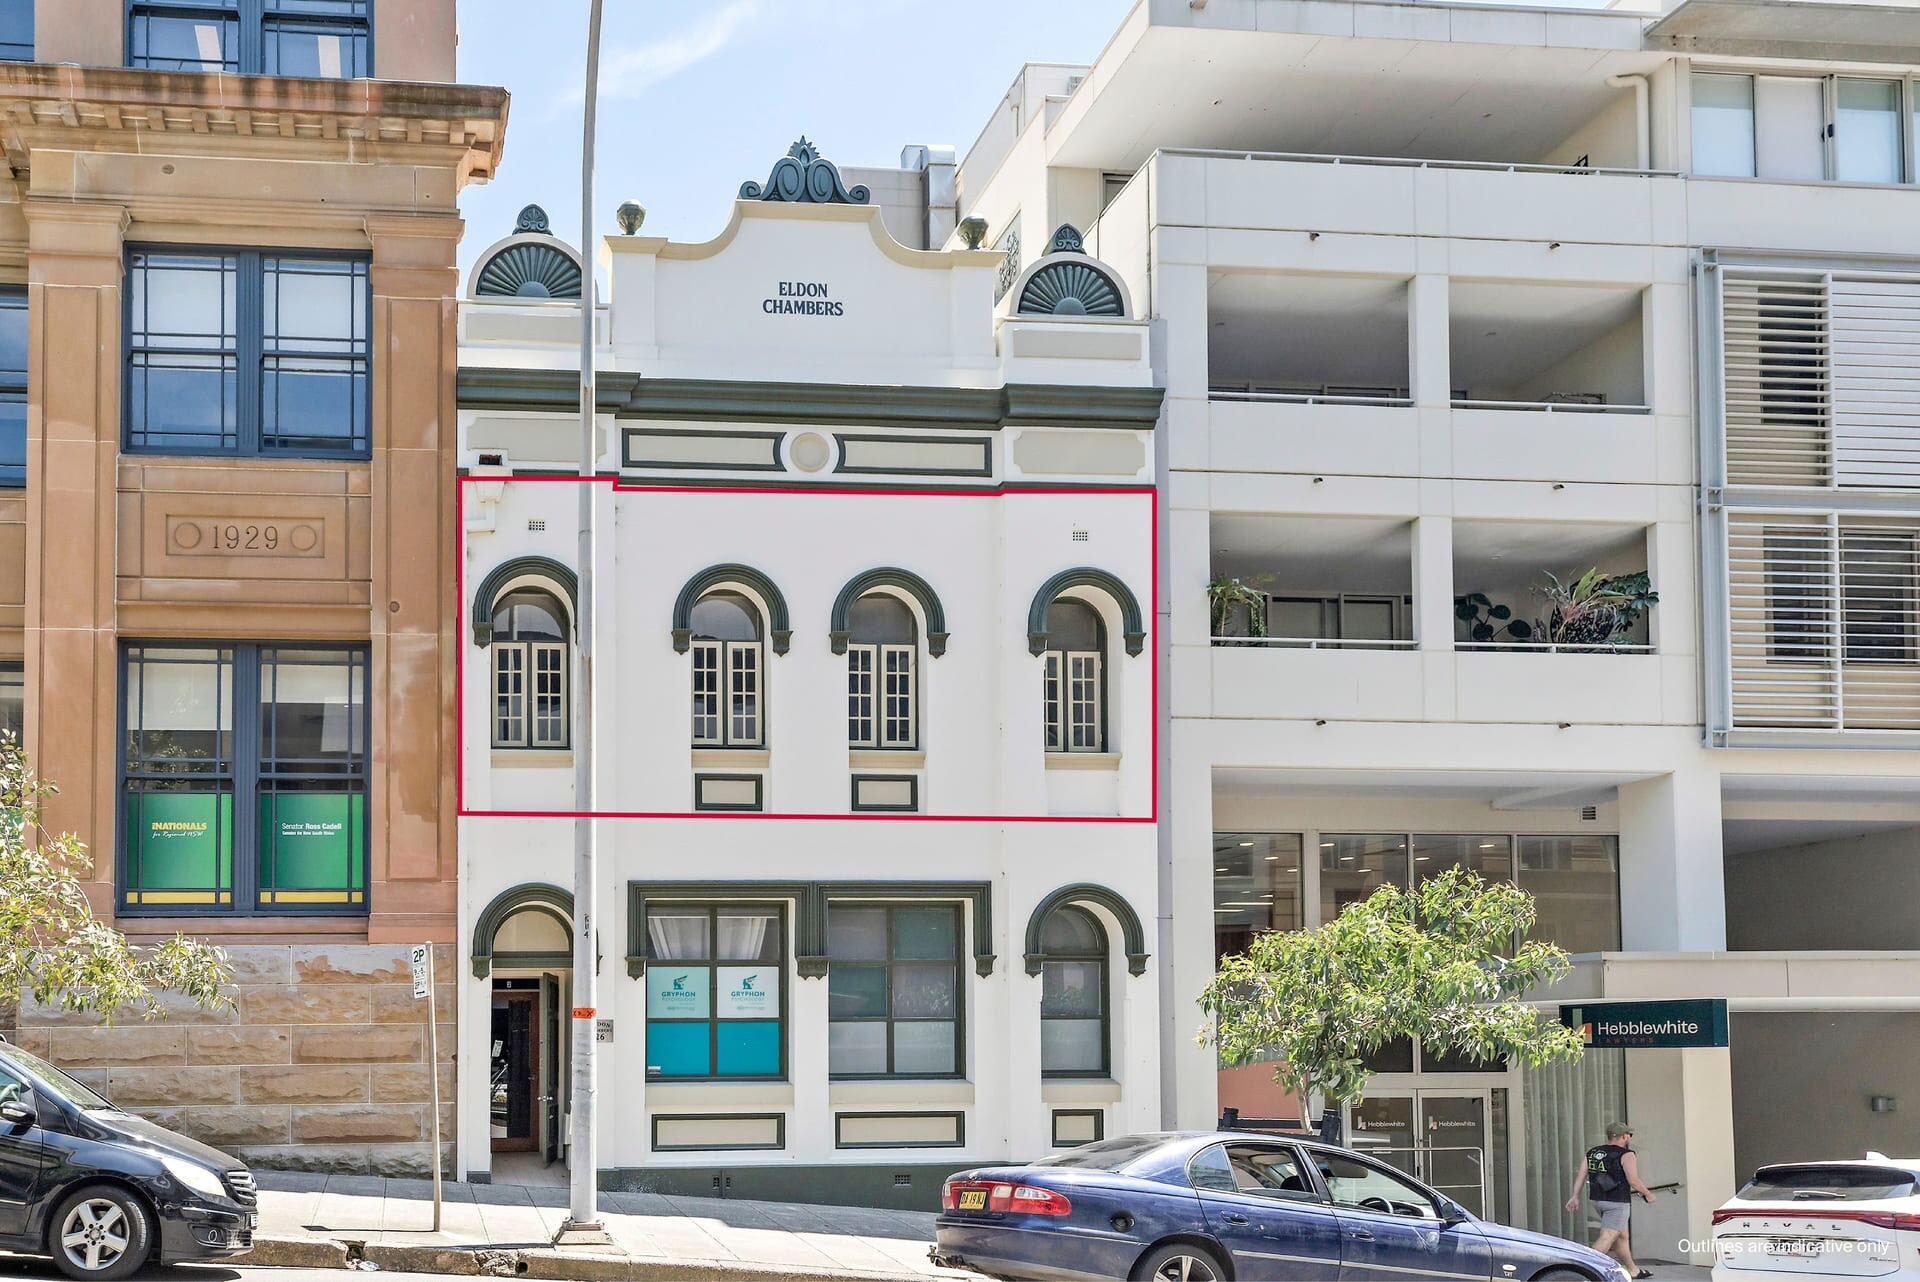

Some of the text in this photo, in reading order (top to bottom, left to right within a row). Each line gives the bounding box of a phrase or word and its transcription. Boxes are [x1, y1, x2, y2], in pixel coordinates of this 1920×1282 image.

[779, 281, 828, 298] ELDON
[762, 299, 844, 317] CHAMBERS
[213, 525, 279, 550] 1929
[282, 822, 342, 830] Senator Ross Cadell
[413, 949, 425, 963] 2P
[1598, 1020, 1699, 1036] Hebblewhite
[1742, 1221, 1841, 1231] HAVAL
